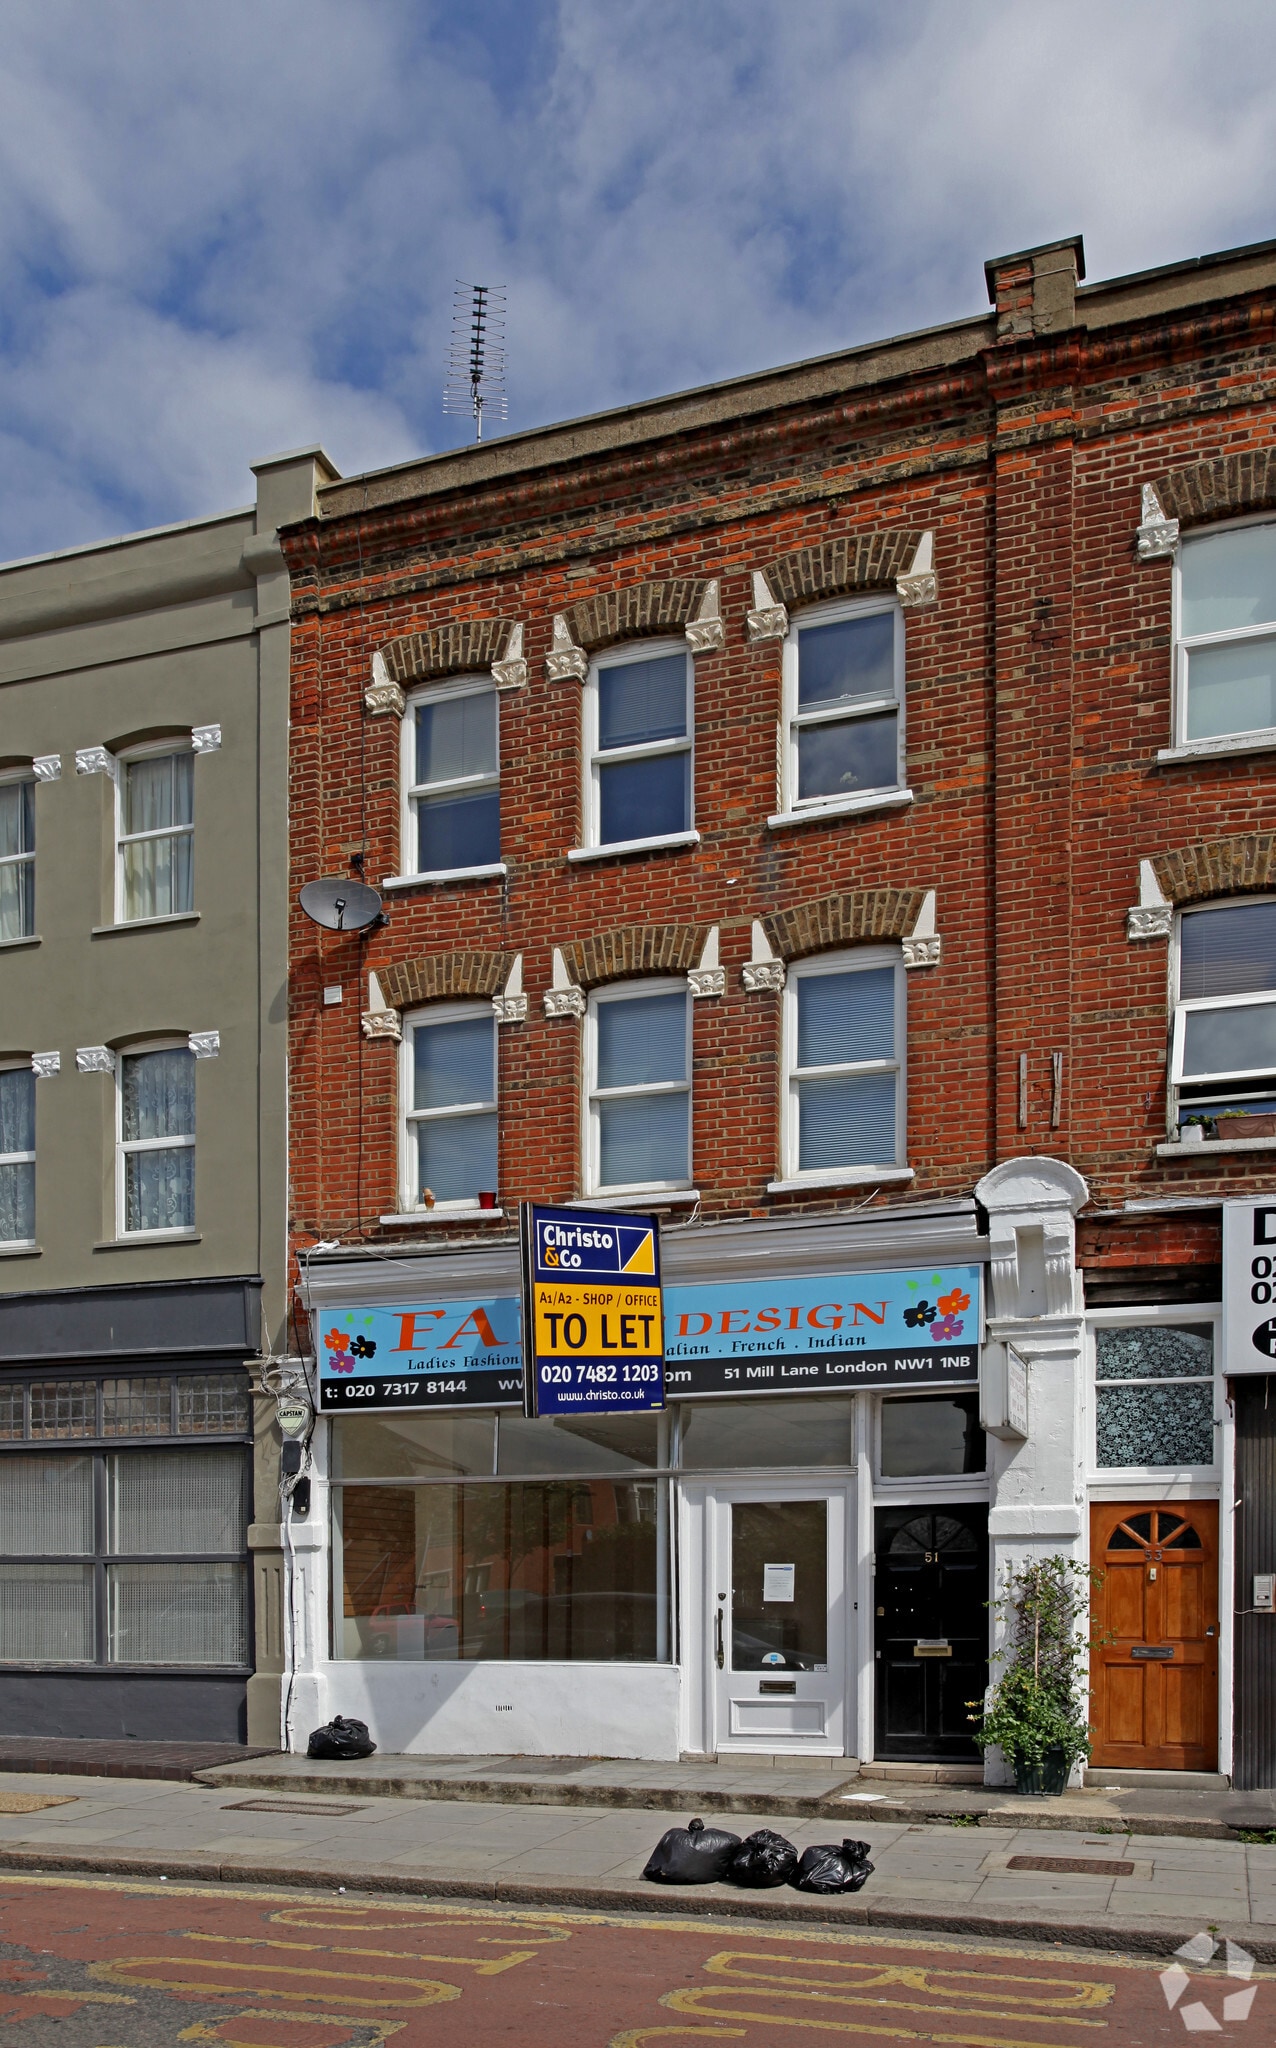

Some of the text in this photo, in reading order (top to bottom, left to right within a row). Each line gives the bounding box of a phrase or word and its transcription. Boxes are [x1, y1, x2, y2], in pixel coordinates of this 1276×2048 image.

[543, 1224, 614, 1249] Christo
[544, 1247, 582, 1268] &Co
[539, 1291, 572, 1306] A1/A2
[583, 1292, 613, 1306] SHOP
[625, 1294, 658, 1307] OFFICE
[388, 1301, 895, 1353] FA DESIGN
[543, 1312, 655, 1349] TO LET
[408, 1356, 456, 1371] Ladies
[666, 1343, 710, 1357] alian
[731, 1336, 786, 1353] French
[808, 1333, 867, 1349] Indian
[325, 1386, 338, 1398] t:
[345, 1384, 375, 1398] 020
[382, 1382, 420, 1396] 7317
[427, 1380, 467, 1394] 8144
[665, 1370, 692, 1382] om
[724, 1368, 741, 1380] 51
[746, 1364, 775, 1378] Mill
[781, 1363, 819, 1377] Lane
[825, 1360, 888, 1375] London
[894, 1358, 934, 1371] NW1
[940, 1356, 971, 1369] 1NB
[541, 1364, 659, 1384] 020 7482 1203
[557, 1388, 645, 1402] www.christo.co.uk
[924, 1552, 939, 1563] 51
[1144, 1549, 1163, 1562] 53
